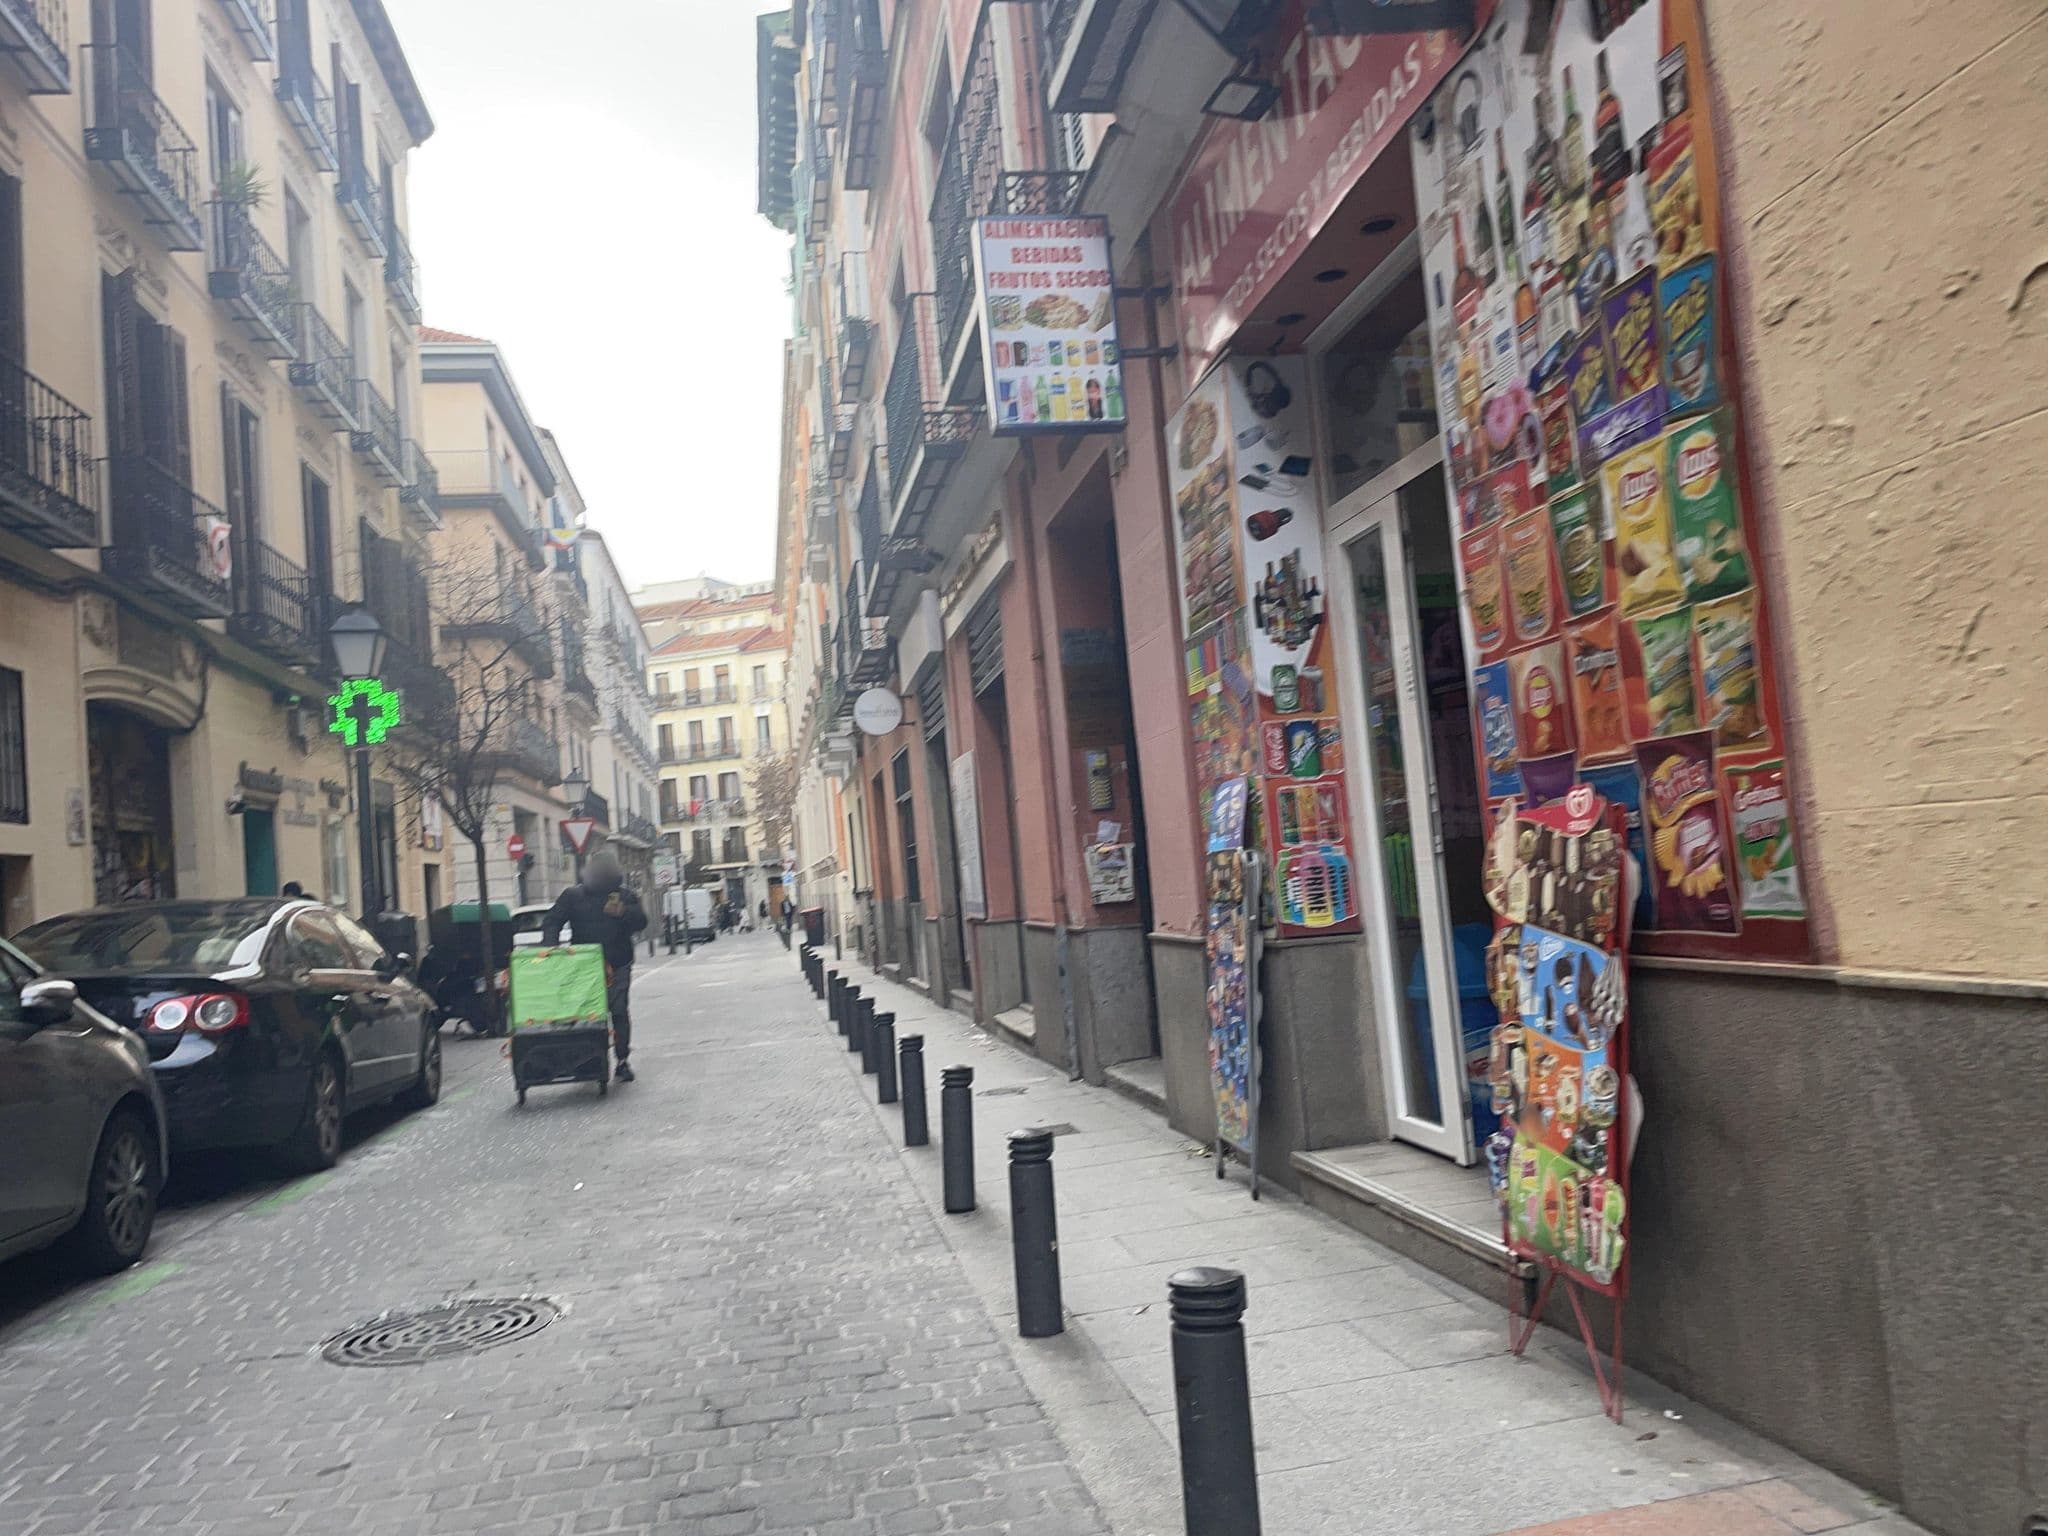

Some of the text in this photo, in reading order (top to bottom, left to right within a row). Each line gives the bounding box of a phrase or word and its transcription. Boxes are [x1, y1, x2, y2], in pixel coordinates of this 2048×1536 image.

[1256, 191, 1313, 282] SECOS
[1325, 41, 1422, 192] BEBIDAS
[1011, 246, 1083, 264] BEBIDAS
[989, 269, 1111, 288] FRUTOS SECOS
[1303, 864, 1328, 914] PRIME
